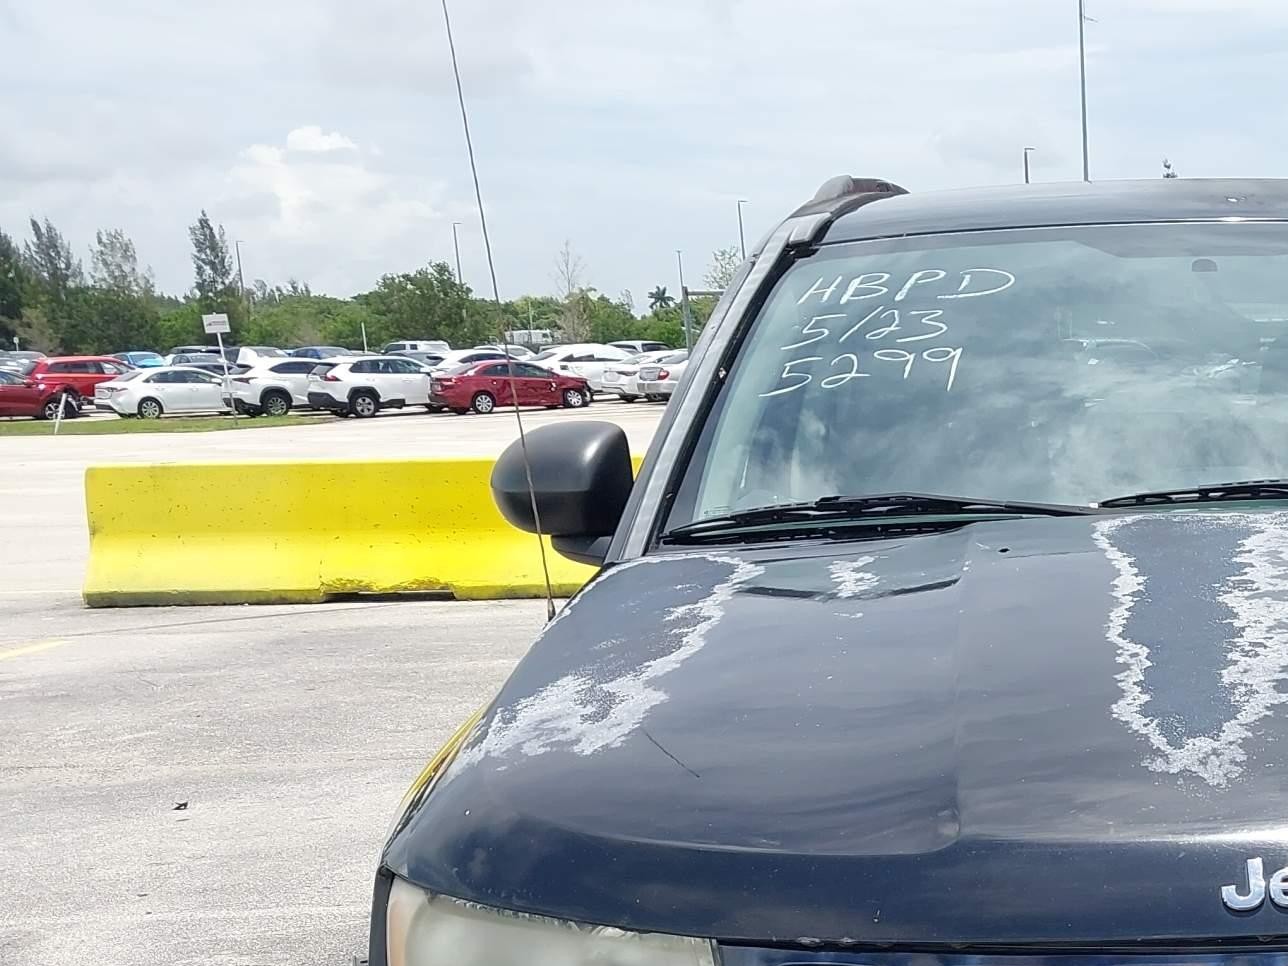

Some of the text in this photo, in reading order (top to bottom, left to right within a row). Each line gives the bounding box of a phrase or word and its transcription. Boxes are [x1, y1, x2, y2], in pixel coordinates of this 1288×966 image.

[797, 268, 1016, 305] HBPD
[780, 306, 949, 350] 5/23
[758, 347, 964, 398] 5299
